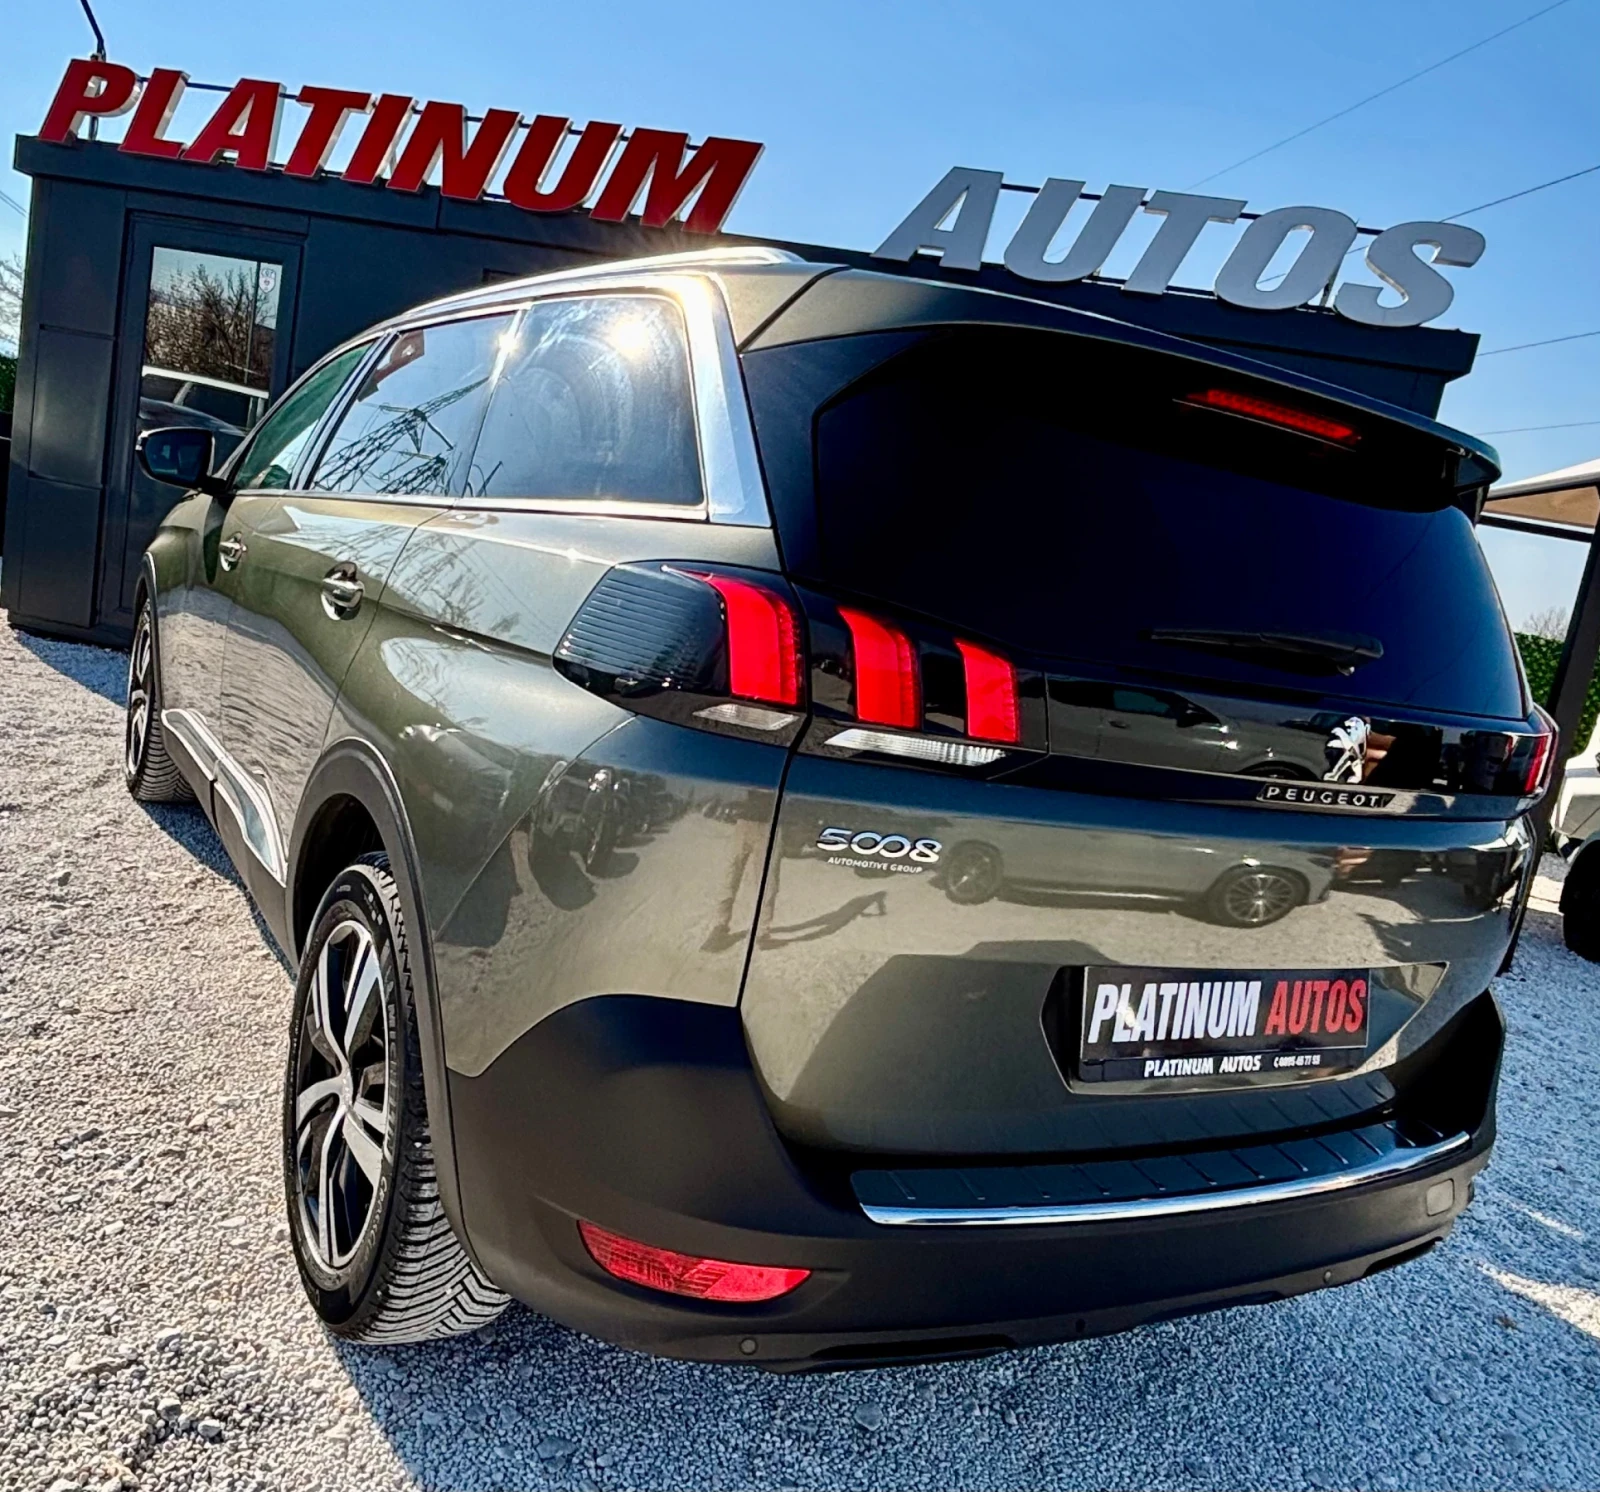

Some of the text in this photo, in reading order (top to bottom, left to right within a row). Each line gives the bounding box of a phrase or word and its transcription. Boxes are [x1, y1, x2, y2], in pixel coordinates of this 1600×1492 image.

[38, 58, 1486, 327] PLATINUM AUTOS
[1266, 786, 1380, 807] PEUGEOT
[816, 826, 943, 863] 5008
[827, 856, 923, 874] AUTOMOTIVE GROUP
[1087, 979, 1367, 1043] PLATINUM AUTOS
[1144, 1057, 1214, 1078] PLATINUM
[1218, 1055, 1262, 1074] AUTOS
